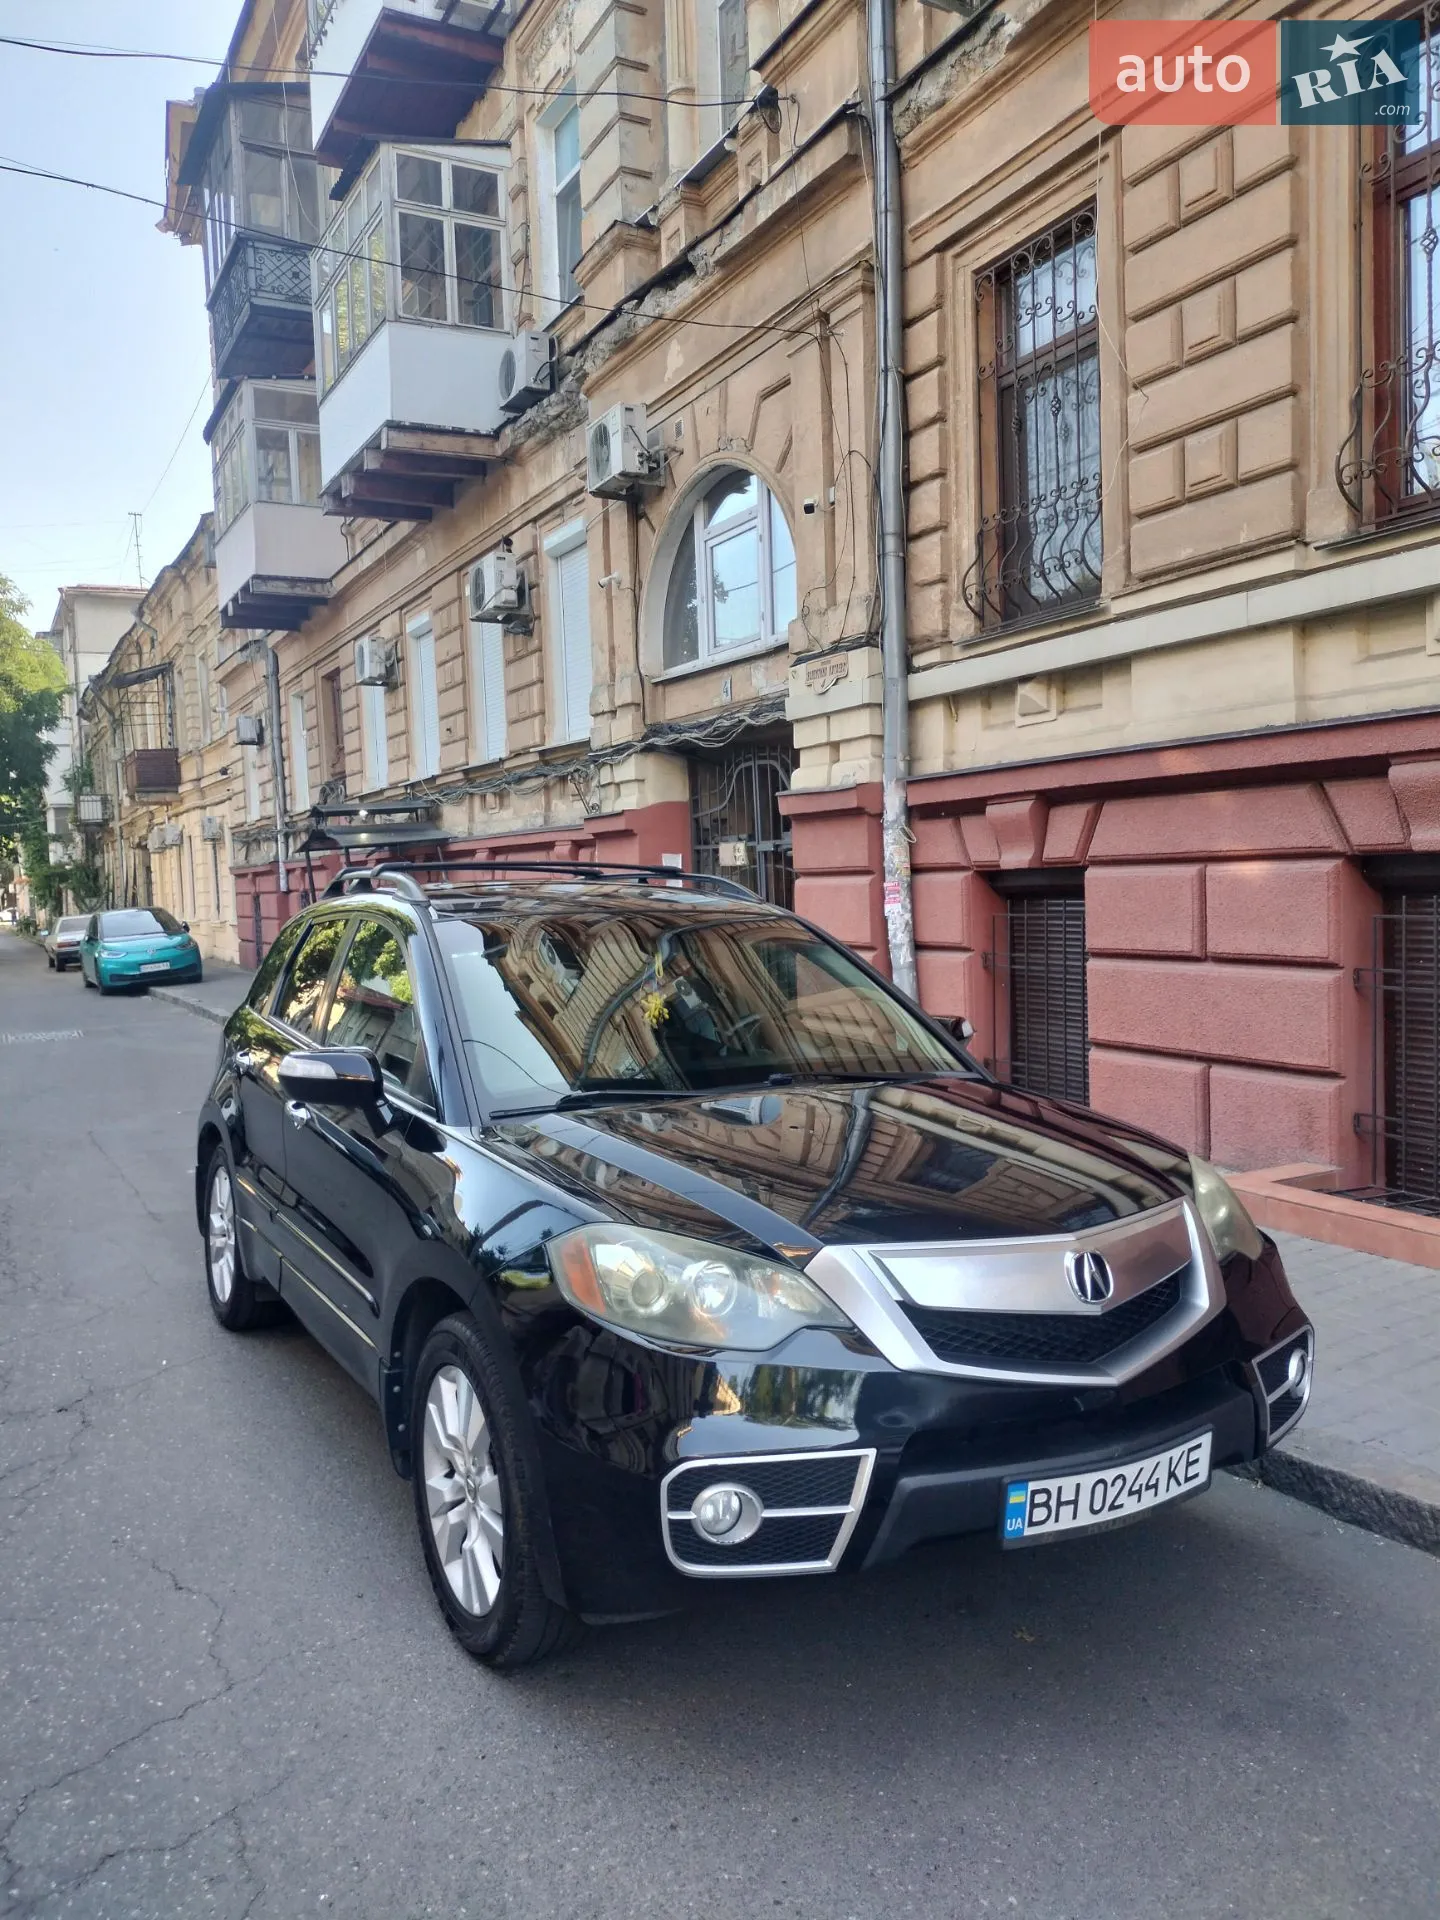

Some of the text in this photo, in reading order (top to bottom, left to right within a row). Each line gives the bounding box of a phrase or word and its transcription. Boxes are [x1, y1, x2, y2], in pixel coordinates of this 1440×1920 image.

[1027, 1442, 1202, 1528] BH 0244 KE
[1006, 1517, 1023, 1531] UA
